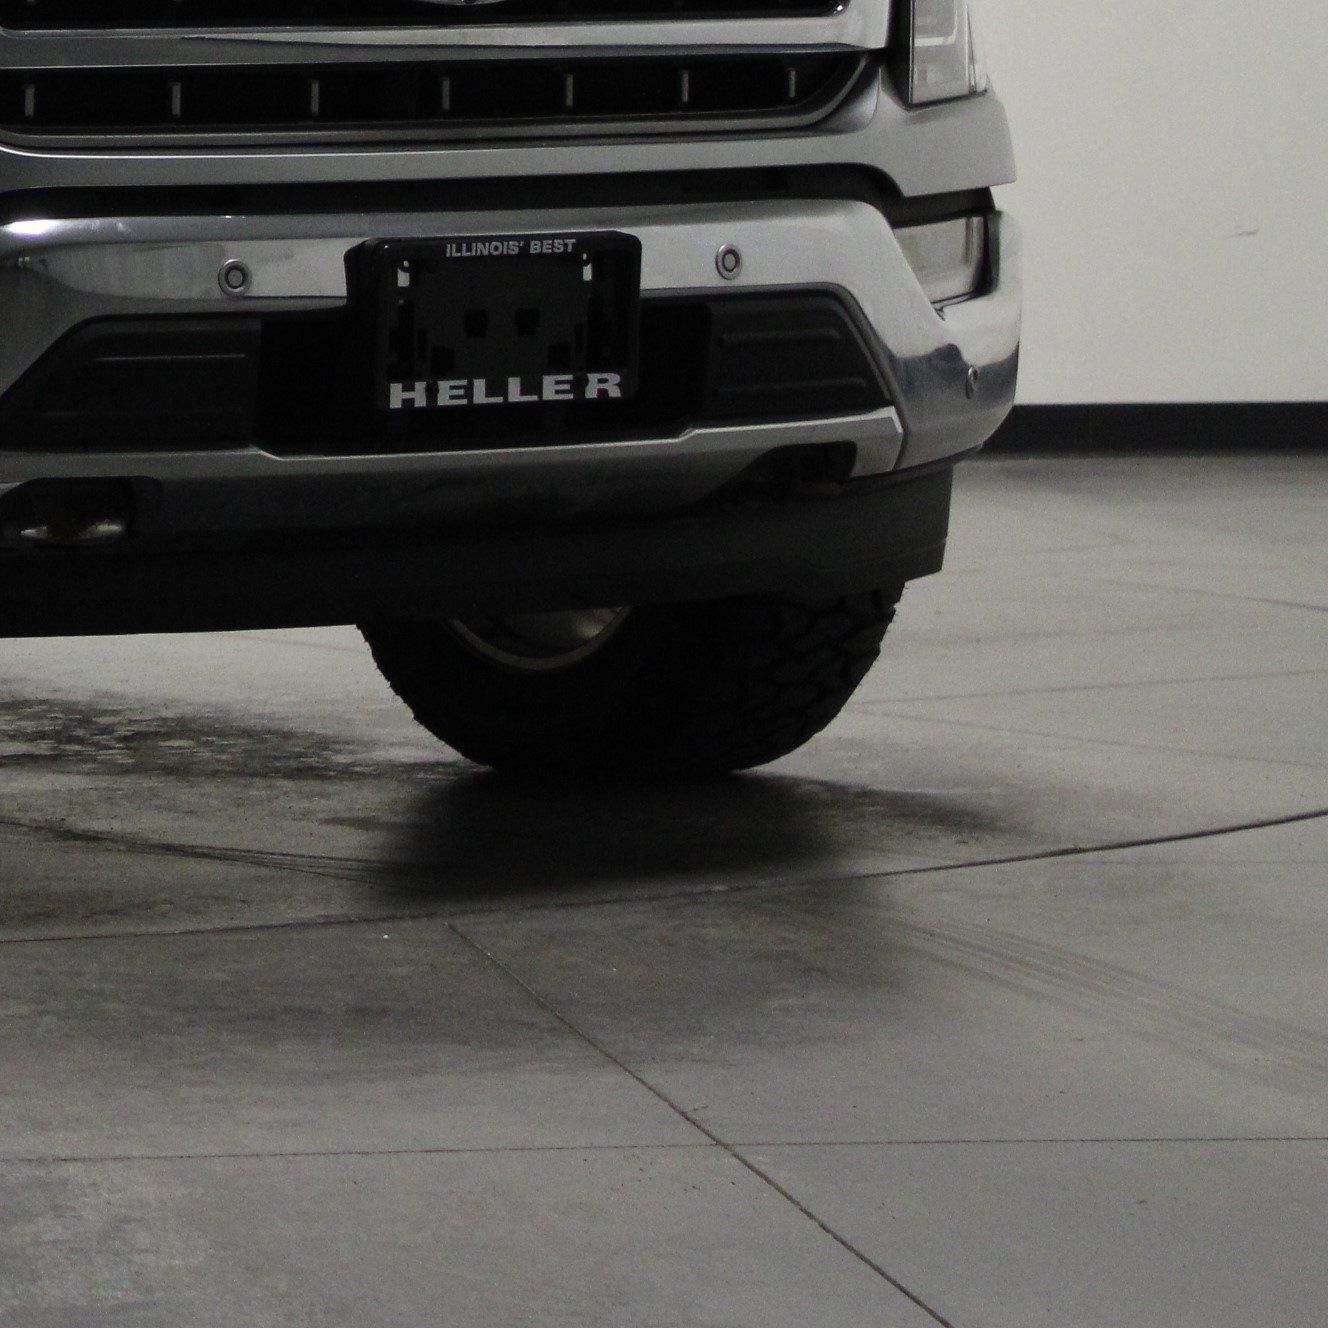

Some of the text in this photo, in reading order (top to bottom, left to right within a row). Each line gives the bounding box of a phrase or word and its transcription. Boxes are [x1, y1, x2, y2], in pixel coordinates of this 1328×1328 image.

[445, 238, 577, 258] ILLINOIS' BEST
[388, 372, 623, 410] HELLER
